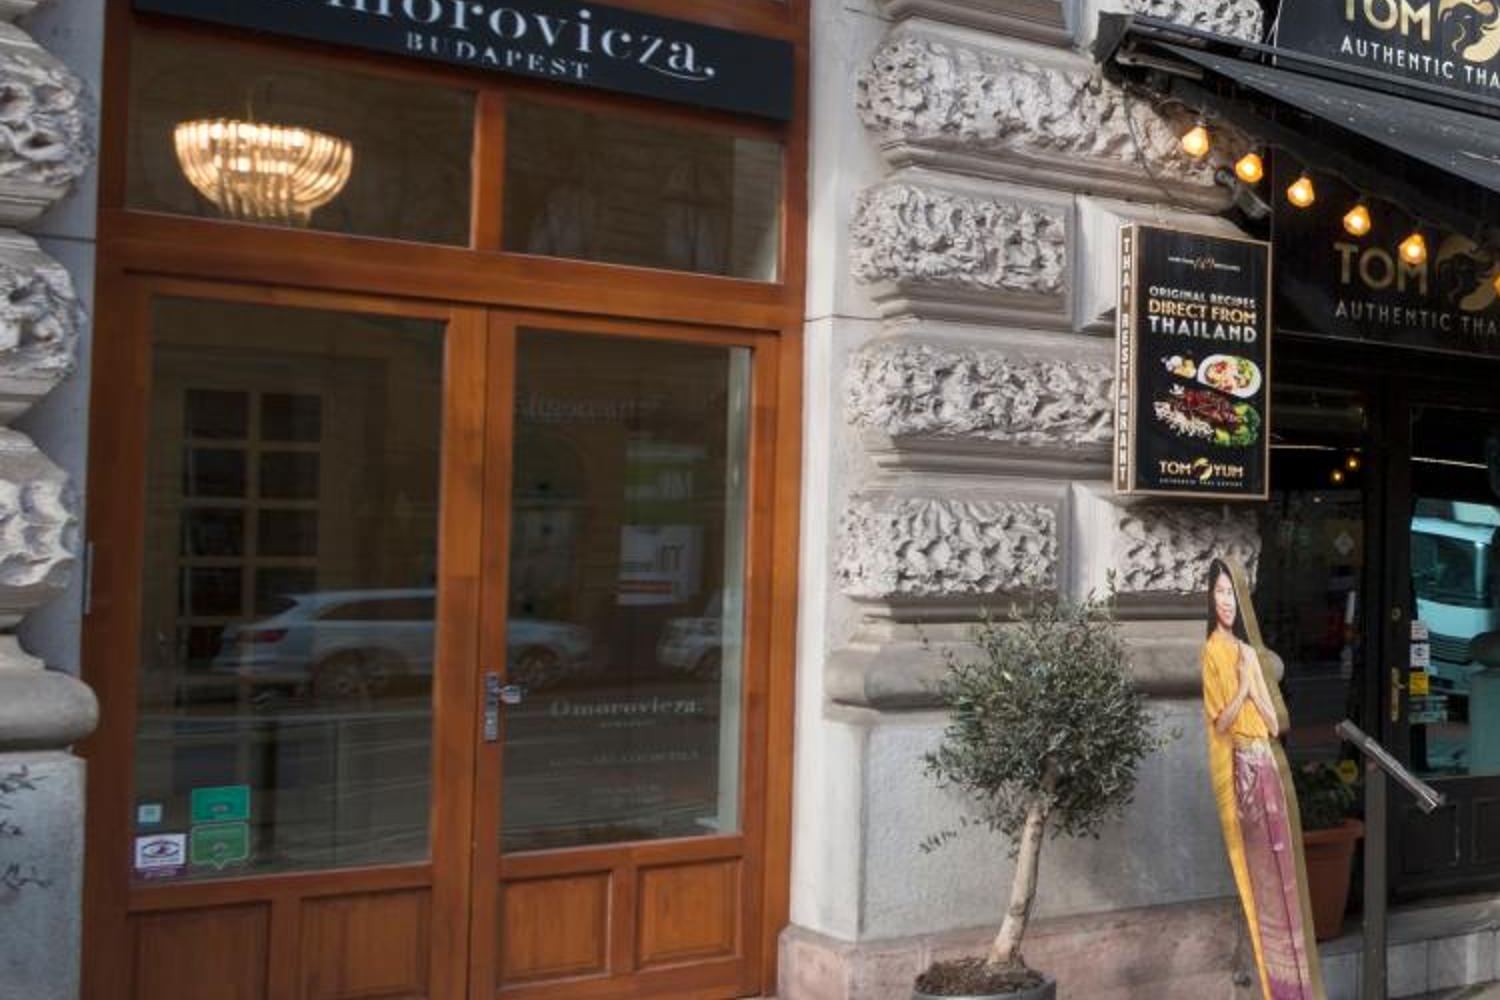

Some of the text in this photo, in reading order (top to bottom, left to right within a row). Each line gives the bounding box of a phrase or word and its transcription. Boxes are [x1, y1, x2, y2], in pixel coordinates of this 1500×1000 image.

[405, 30, 590, 79] BUDAPEST
[1340, 35, 1454, 79] AUTHENTIC
[1333, 242, 1428, 295] TOM
[1148, 286, 1256, 309] ORIGINAL RECIPES
[1148, 299, 1257, 325] DIRECT FROM
[1147, 315, 1257, 343] THAILAND
[1335, 300, 1452, 331] AUTHENTIC
[1159, 461, 1244, 479] TOM YUM
